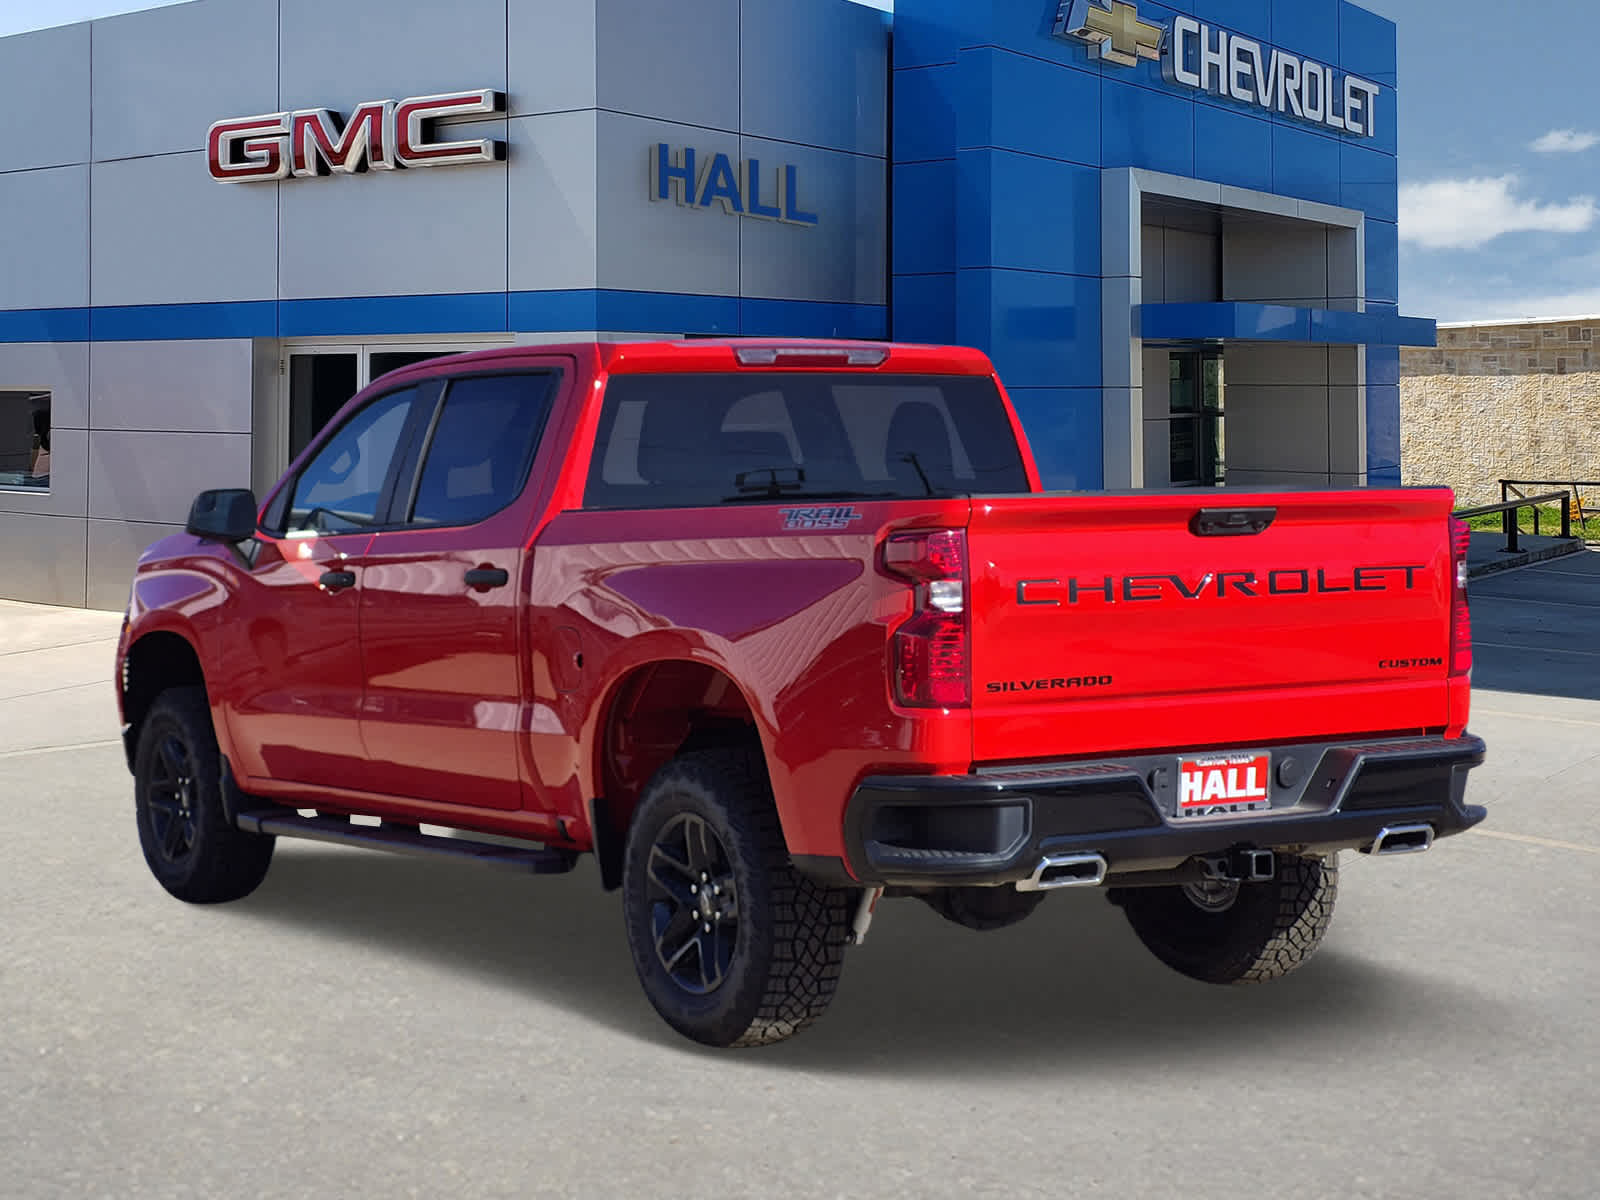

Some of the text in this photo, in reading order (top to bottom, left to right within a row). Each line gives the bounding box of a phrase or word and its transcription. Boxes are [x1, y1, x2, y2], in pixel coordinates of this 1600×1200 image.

[1173, 14, 1380, 137] CHEVROLET
[207, 88, 506, 184] GMC
[652, 142, 818, 226] HALL
[778, 506, 863, 521] TRAIL
[1016, 565, 1425, 606] CHEVROLET
[1378, 657, 1443, 669] CUSTOM
[986, 675, 1113, 693] SILVERADO
[1180, 766, 1266, 803] HALL
